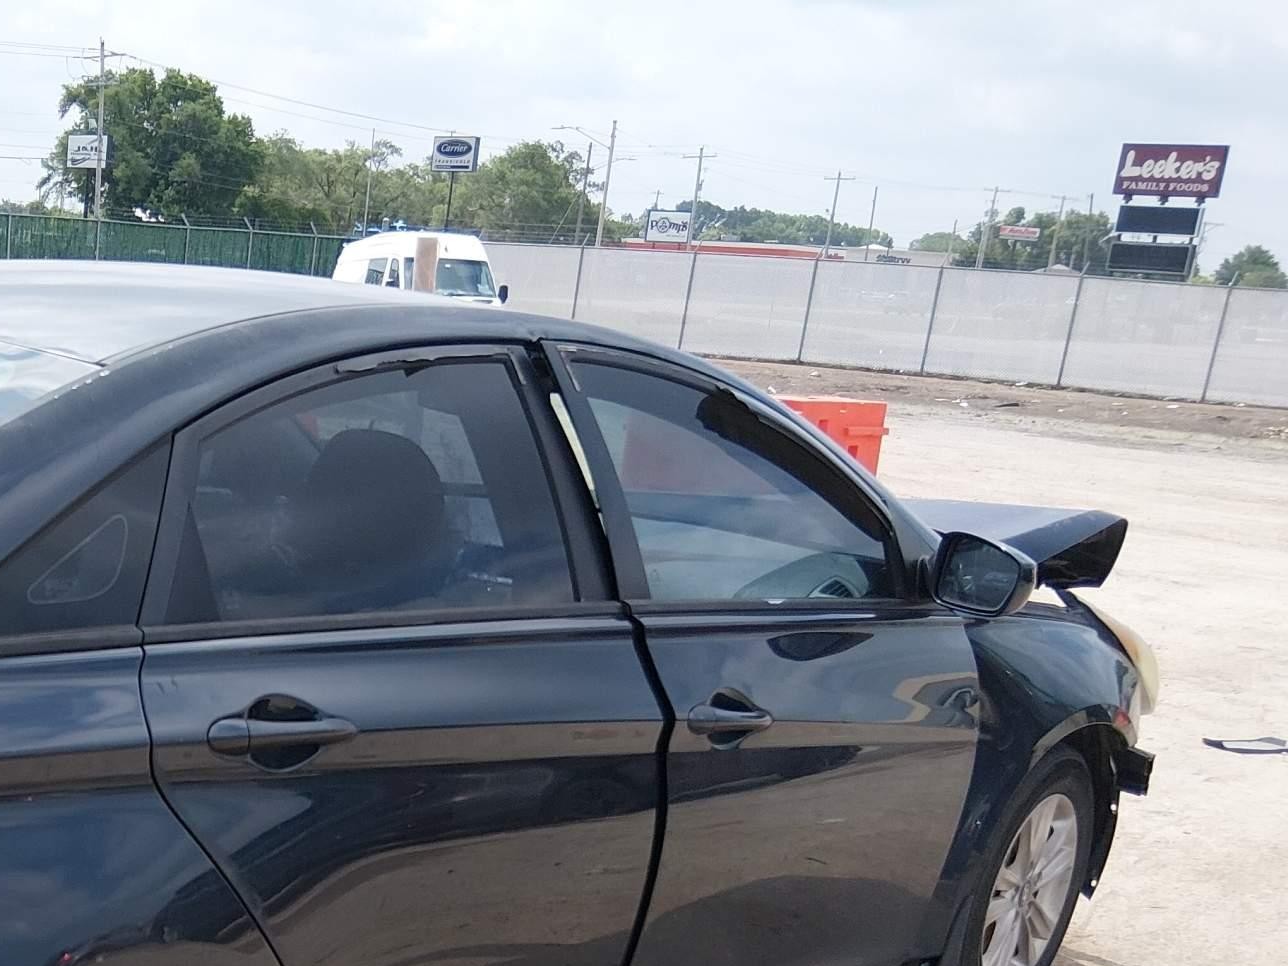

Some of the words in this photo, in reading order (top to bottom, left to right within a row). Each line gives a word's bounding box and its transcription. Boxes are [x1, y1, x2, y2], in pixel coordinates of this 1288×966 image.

[441, 143, 468, 152] Carrier
[1120, 149, 1221, 180] Leeker's
[1122, 181, 1167, 190] FAMILY
[1168, 182, 1209, 192] FOODS
